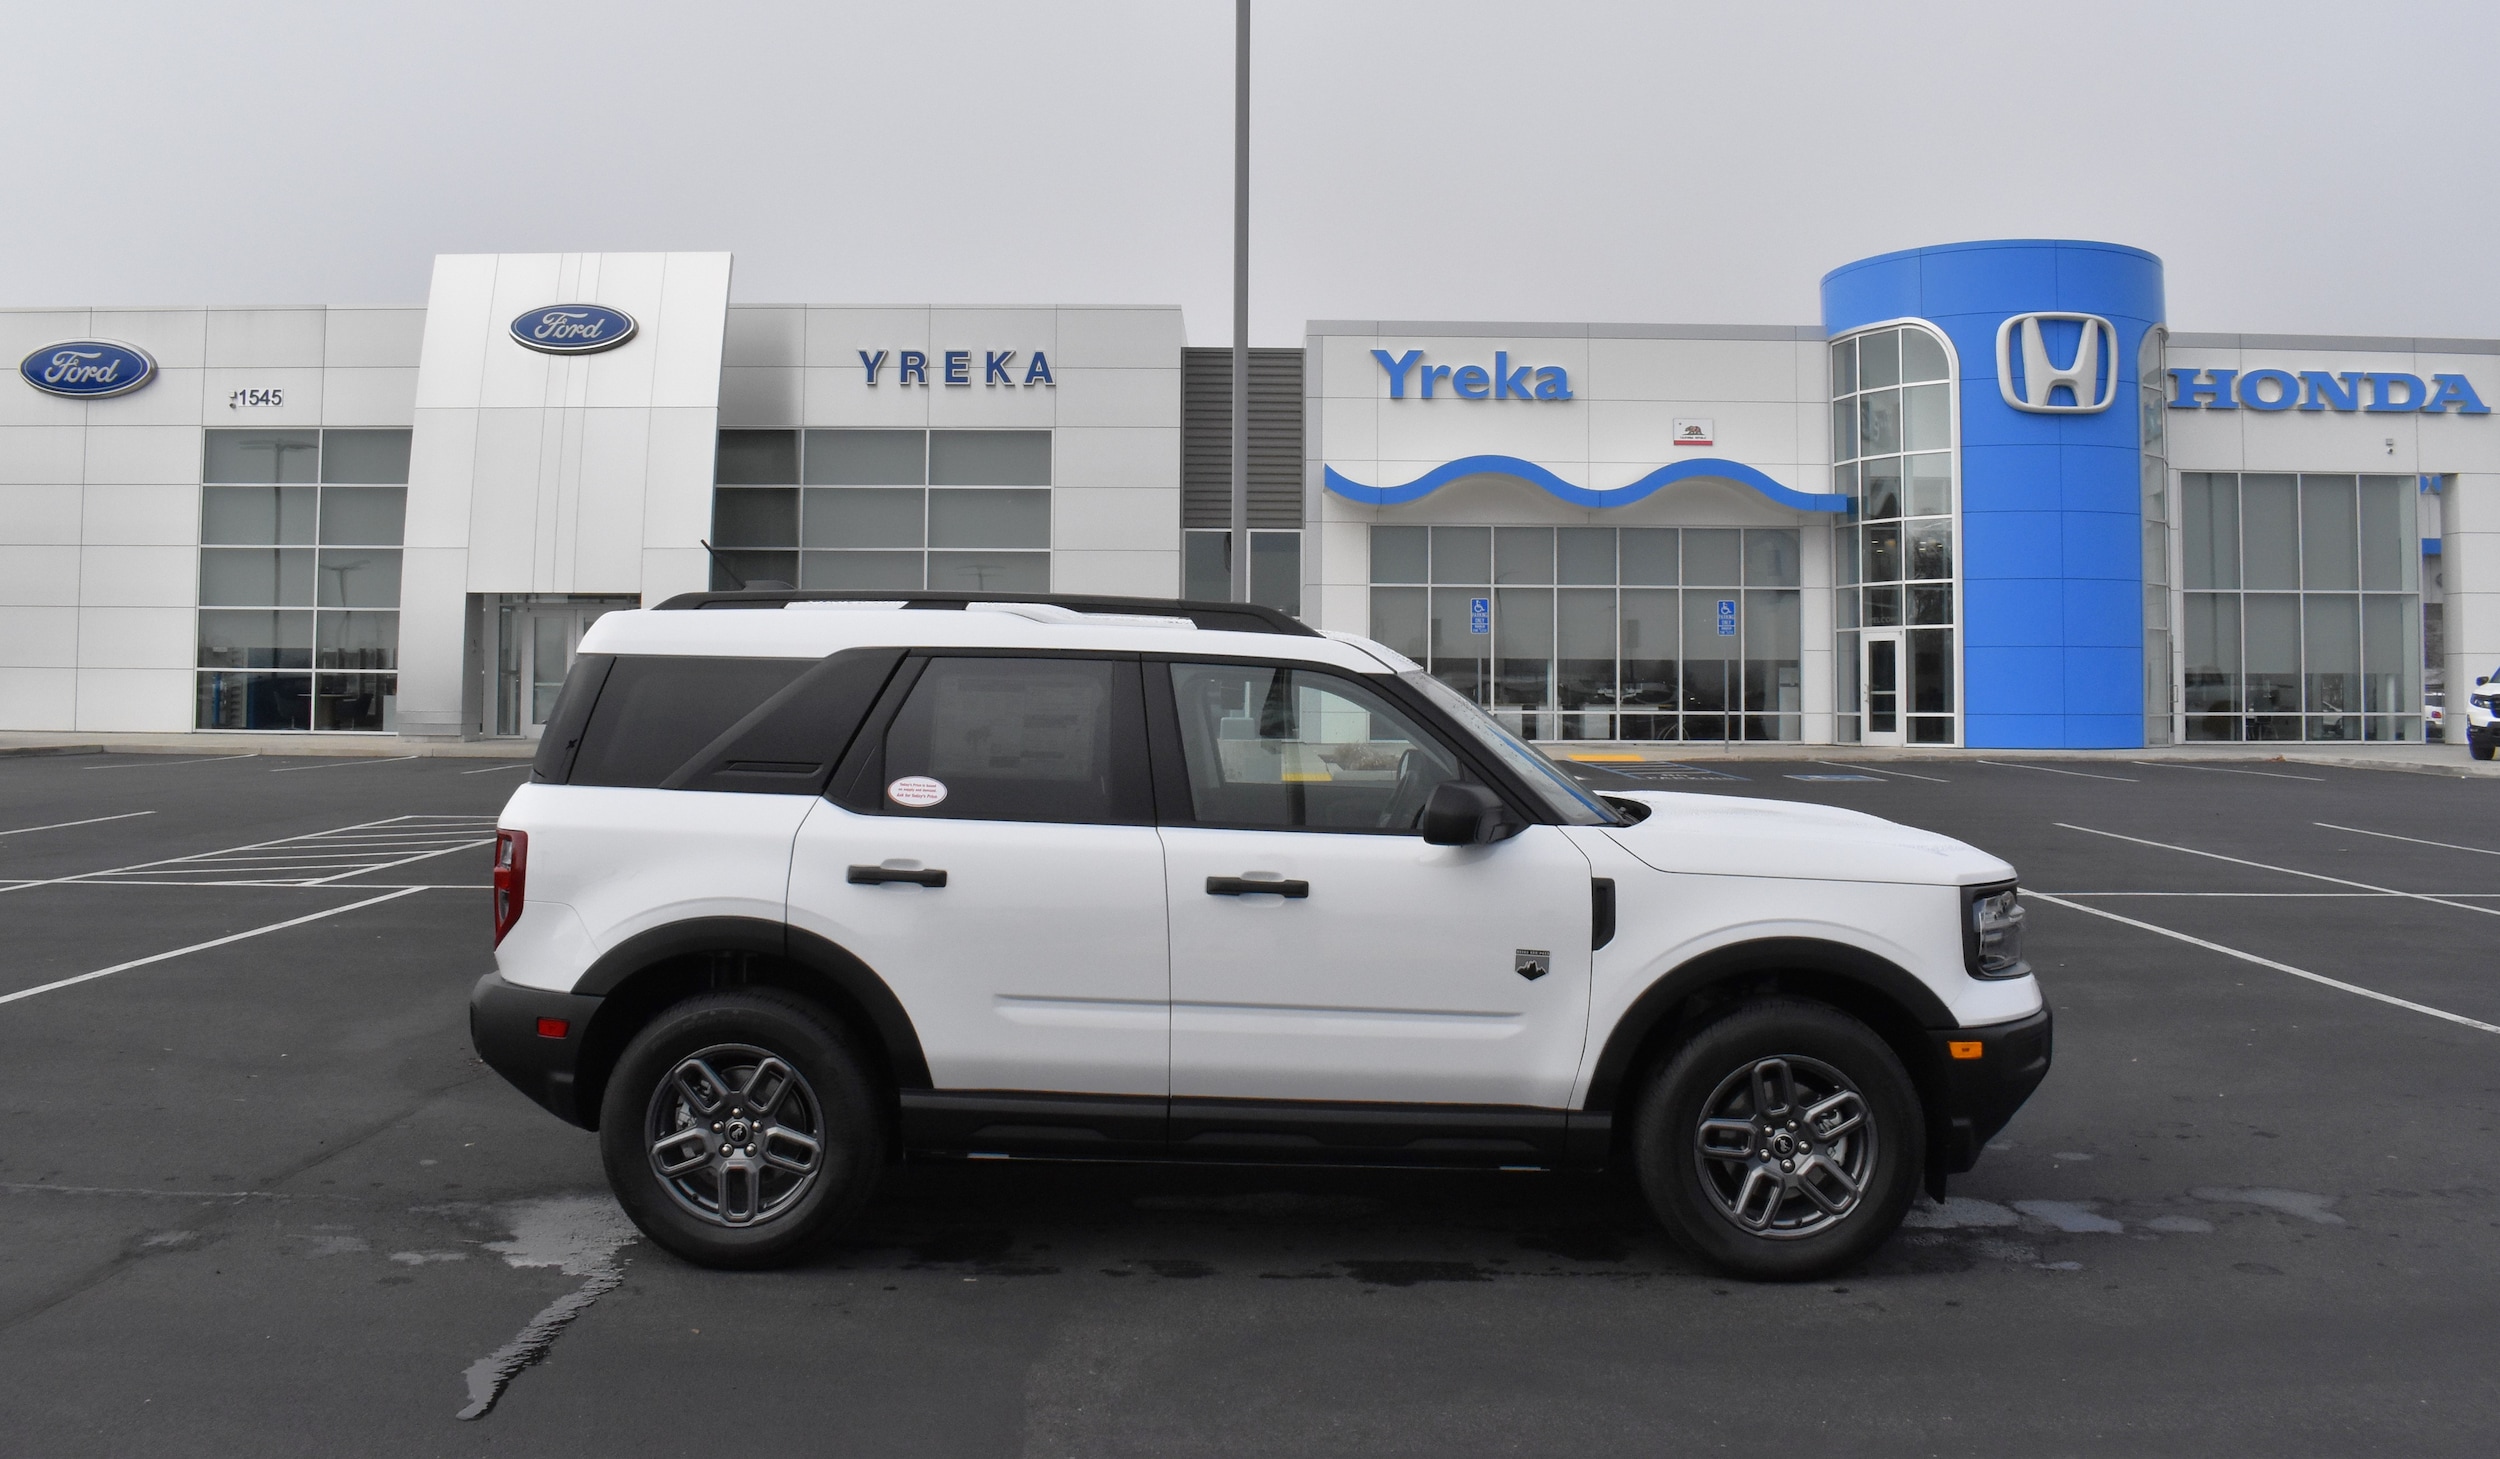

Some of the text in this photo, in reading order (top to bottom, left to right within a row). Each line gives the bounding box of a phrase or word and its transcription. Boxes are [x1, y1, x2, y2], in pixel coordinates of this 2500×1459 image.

[533, 311, 605, 339] Ford
[44, 351, 120, 383] Ford
[859, 350, 1053, 385] YREKA
[1372, 350, 1573, 400] Yreka
[239, 389, 282, 405] 1545
[2168, 368, 2491, 413] HONDA
